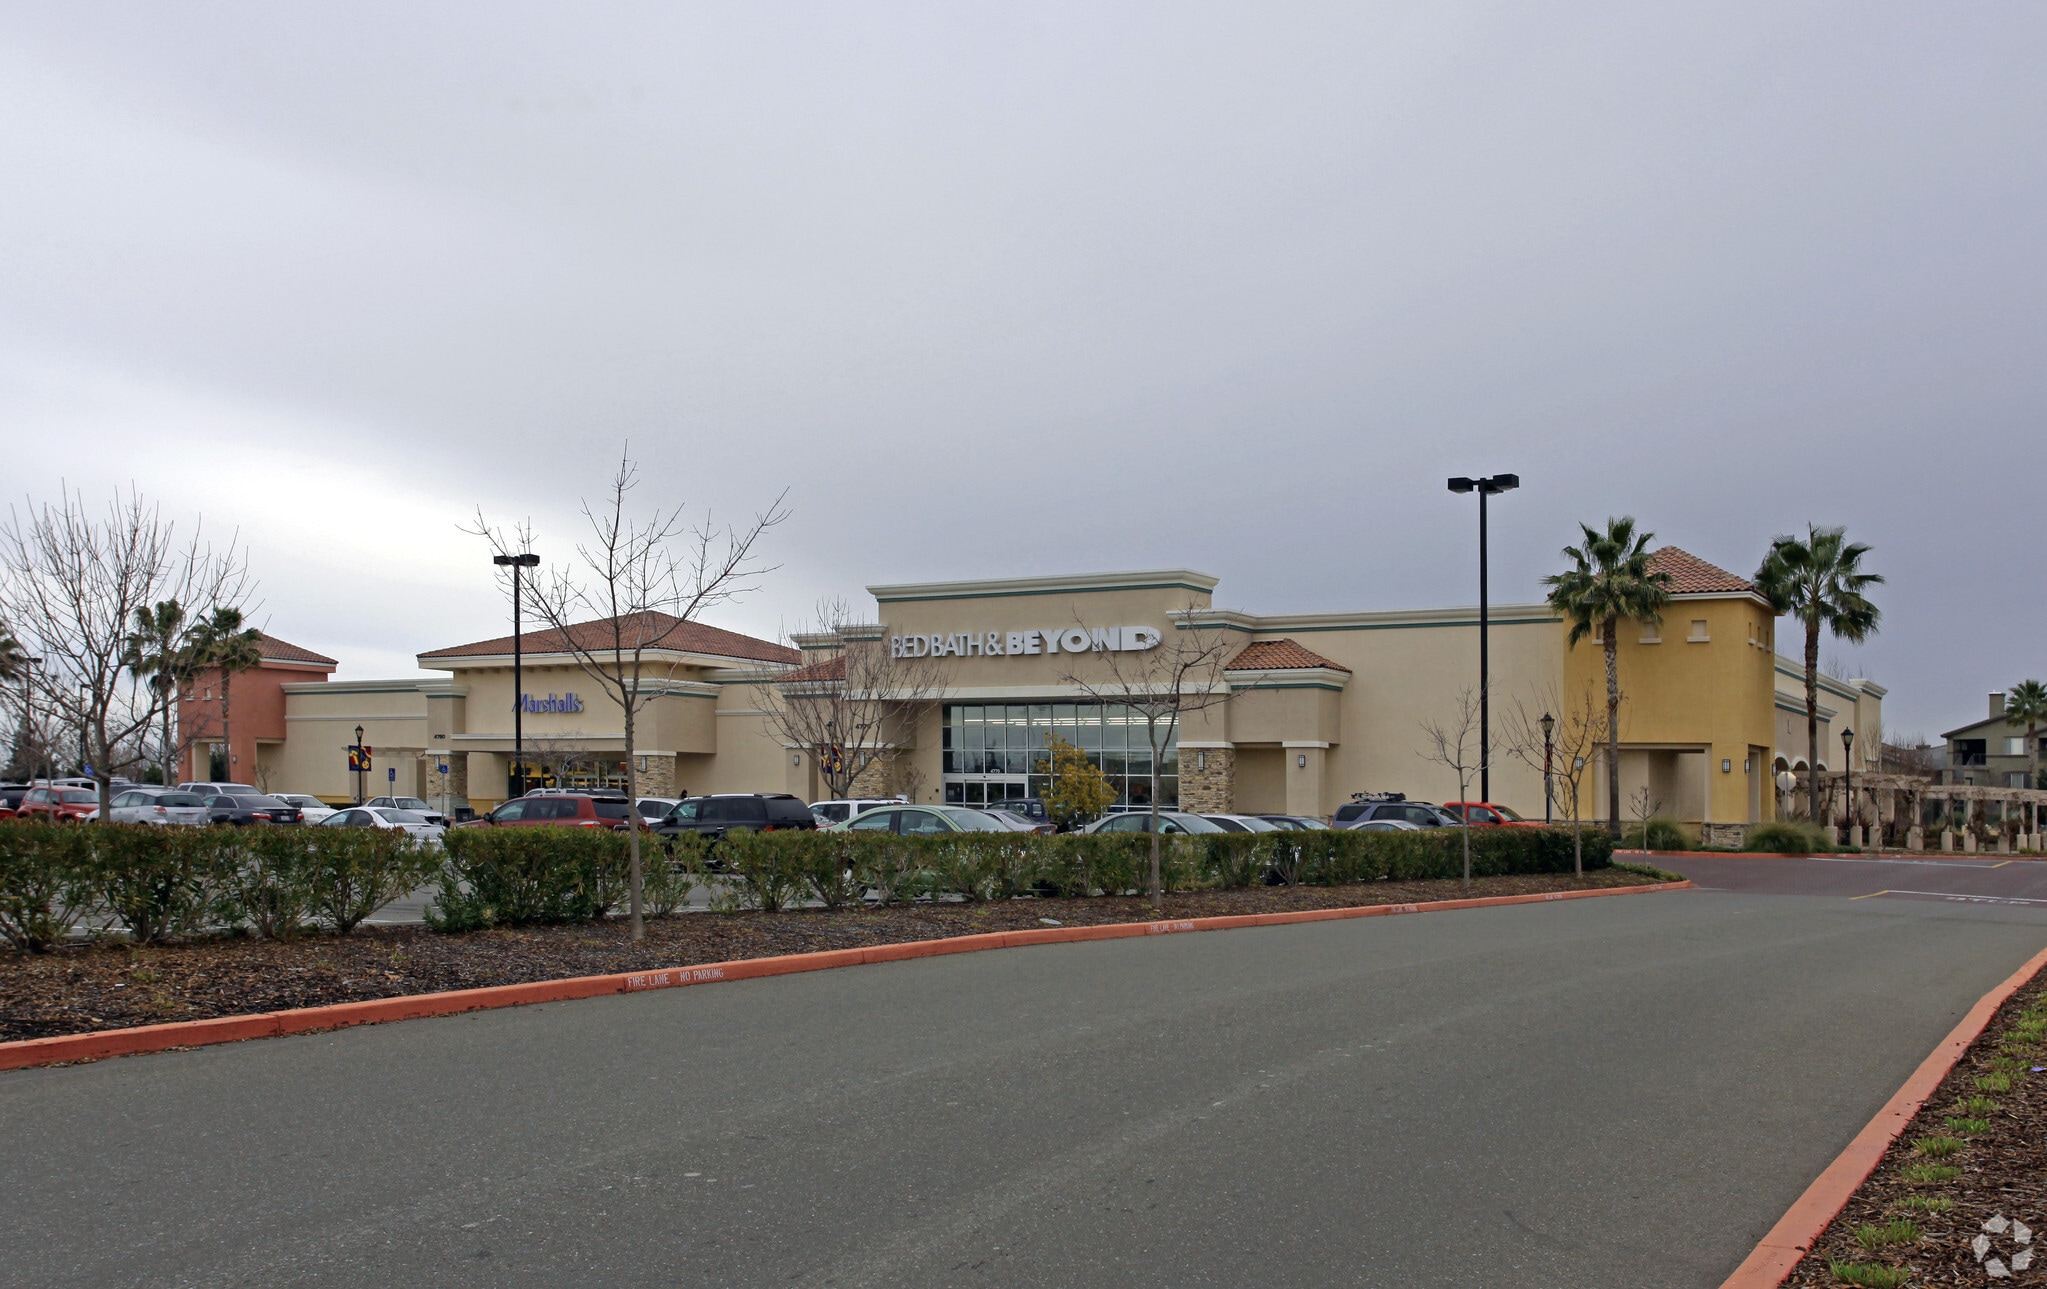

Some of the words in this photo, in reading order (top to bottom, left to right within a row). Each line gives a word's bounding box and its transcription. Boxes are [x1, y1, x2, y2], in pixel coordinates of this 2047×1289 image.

[891, 634, 930, 658] BED
[931, 632, 985, 657] BATH
[986, 631, 1005, 657] &
[1006, 625, 1163, 656] BEYOND
[511, 692, 584, 713] Marshalls
[627, 976, 647, 987] FIRE
[648, 973, 670, 986] LANE
[680, 971, 691, 982] NO
[693, 967, 724, 981] PARKING
